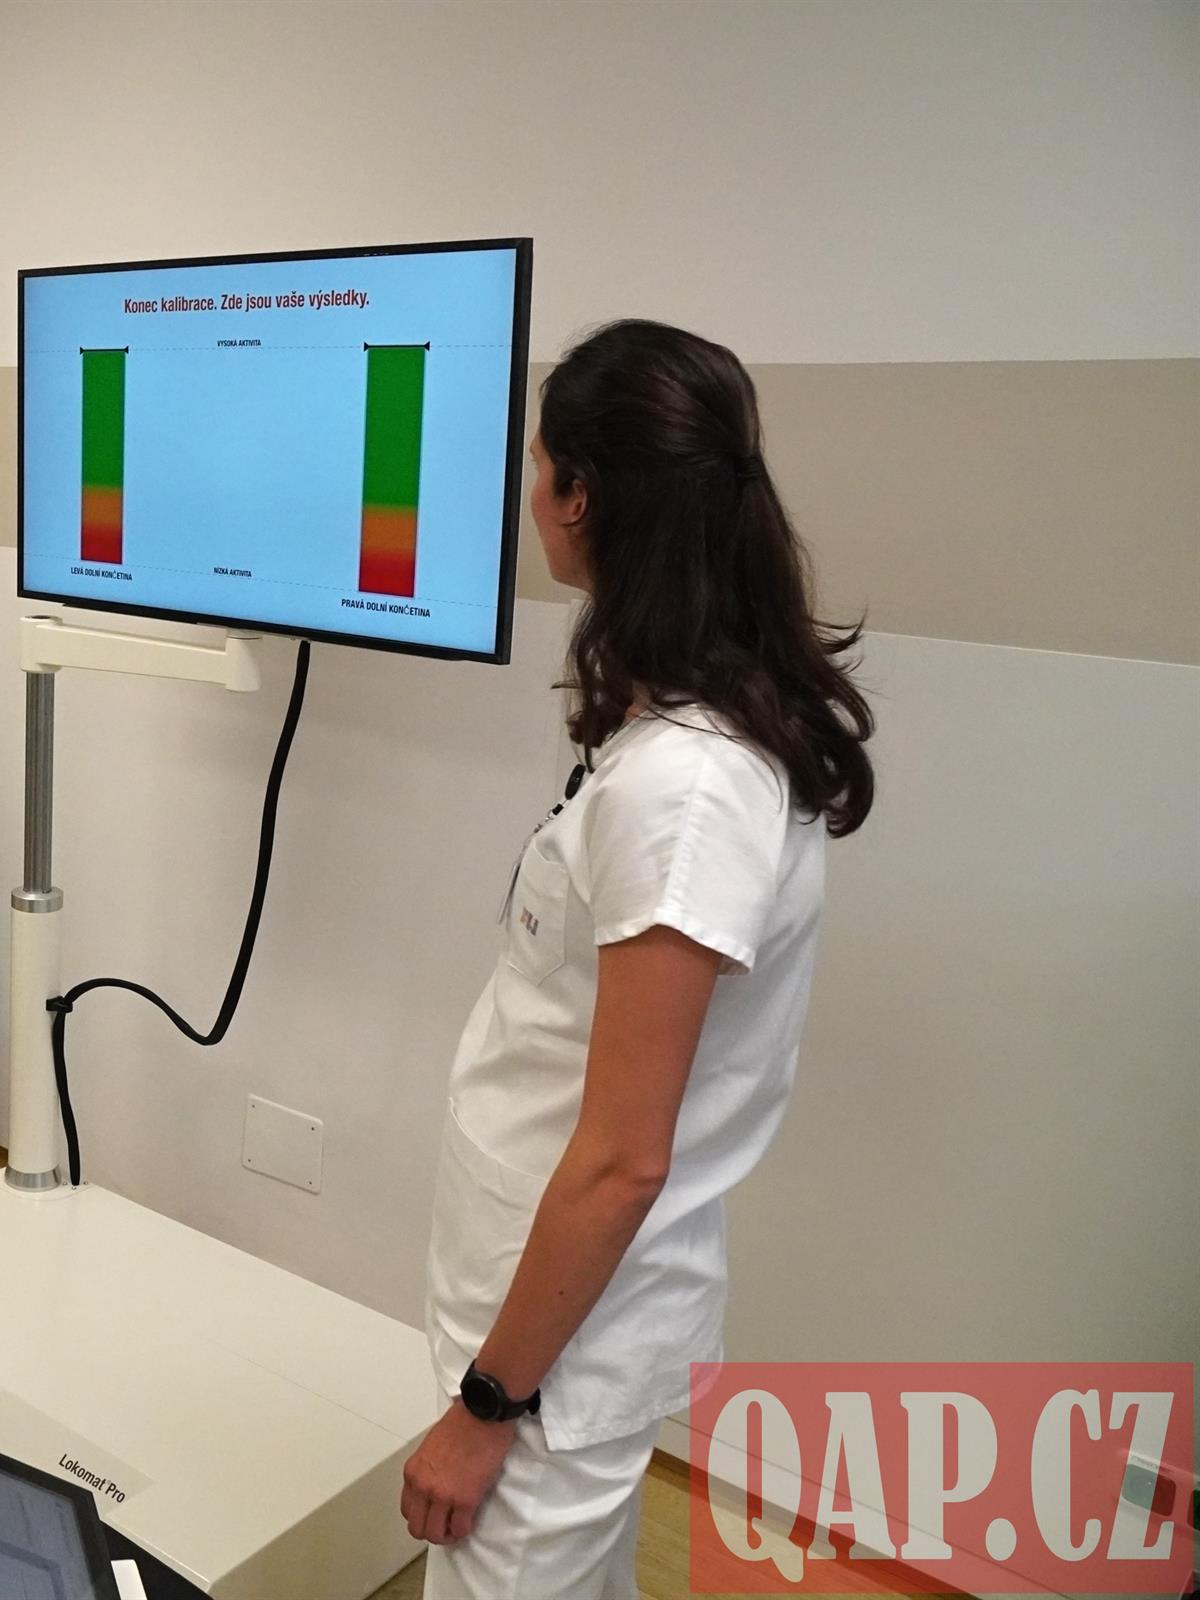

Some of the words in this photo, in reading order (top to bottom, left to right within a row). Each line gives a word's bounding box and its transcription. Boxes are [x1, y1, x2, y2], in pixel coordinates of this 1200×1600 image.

[124, 298, 158, 314] Konec
[161, 296, 217, 312] kalibrace.
[221, 294, 243, 310] Zde
[244, 293, 272, 312] jsou
[275, 291, 305, 308] vaše
[308, 289, 369, 310] výsledky.
[238, 339, 261, 347] AKTIVITA
[229, 568, 252, 577] AKTIVITA
[341, 598, 365, 610] PRAVÁ
[366, 602, 387, 612] DOLNÍ
[389, 605, 431, 618] KONČETINA
[59, 1453, 106, 1491] Lokomat
[105, 1482, 126, 1503] Pro
